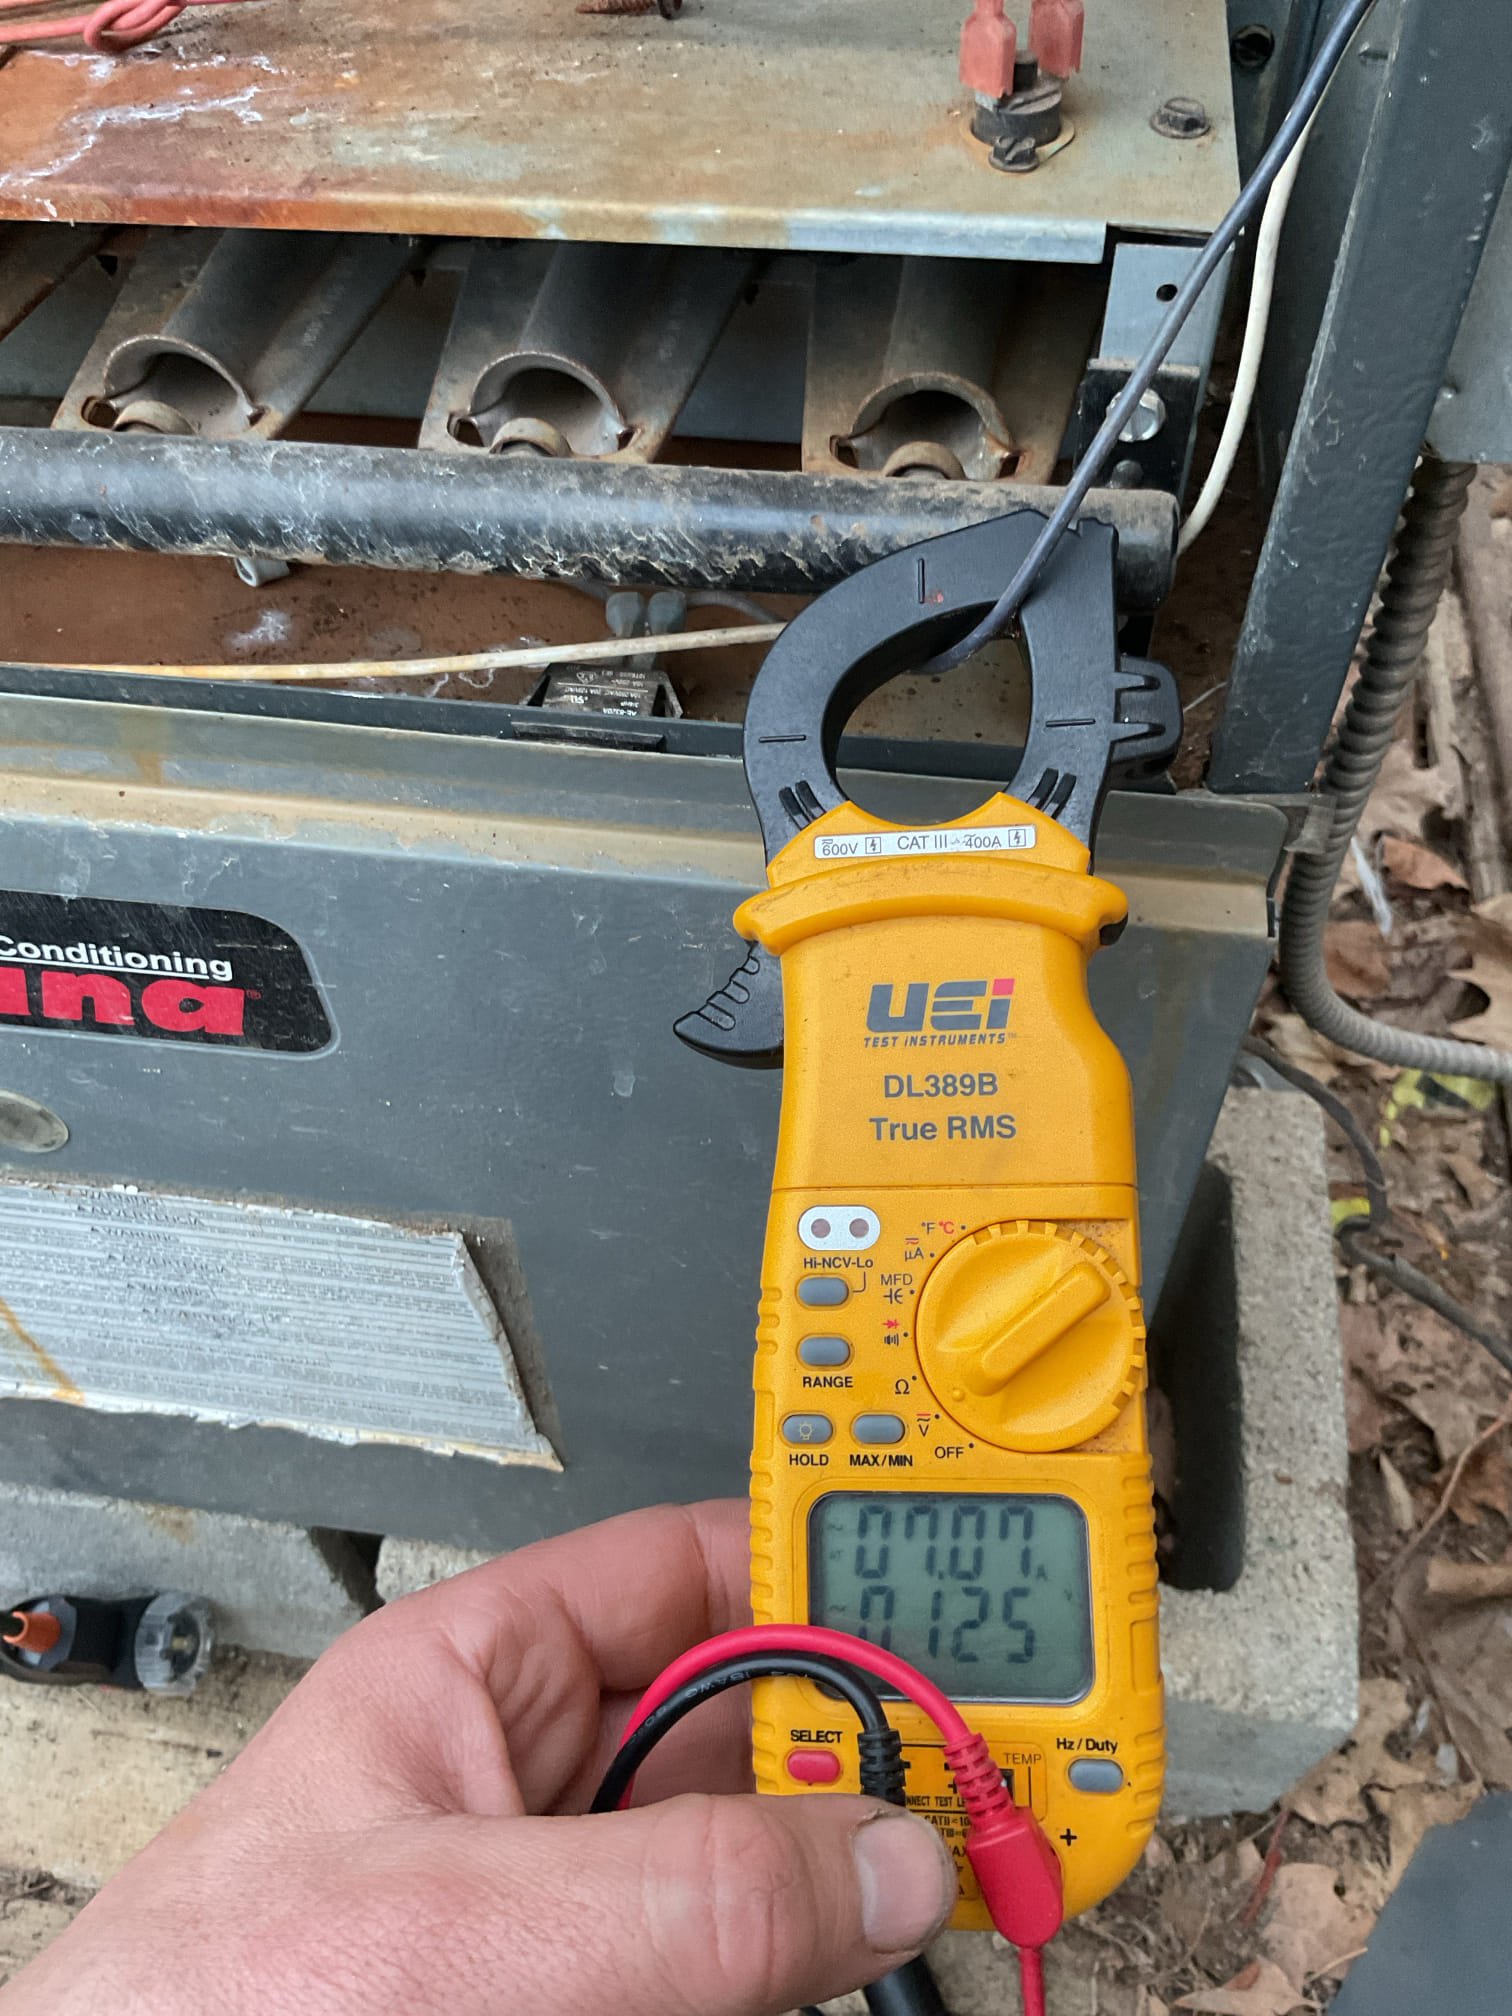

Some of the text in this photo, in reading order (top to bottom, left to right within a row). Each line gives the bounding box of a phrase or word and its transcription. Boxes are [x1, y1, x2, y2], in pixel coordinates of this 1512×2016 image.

[822, 841, 858, 856] 600V
[897, 835, 929, 850] CAT
[0, 935, 233, 982] Conditioning
[864, 1036, 898, 1048] TEST
[884, 1072, 998, 1098] DL389B
[869, 1115, 1017, 1141] True RMS
[804, 1257, 873, 1269] Hi-NCV-Lo
[880, 1273, 912, 1286] MFD
[802, 1376, 853, 1389] RANGE
[934, 1446, 964, 1460] OFF
[789, 1454, 829, 1467] HOLD
[849, 1454, 913, 1467] MAX/MIN
[790, 1730, 843, 1744] SELECT
[1085, 1739, 1118, 1755] Duty
[1004, 1753, 1042, 1765] TEMP
